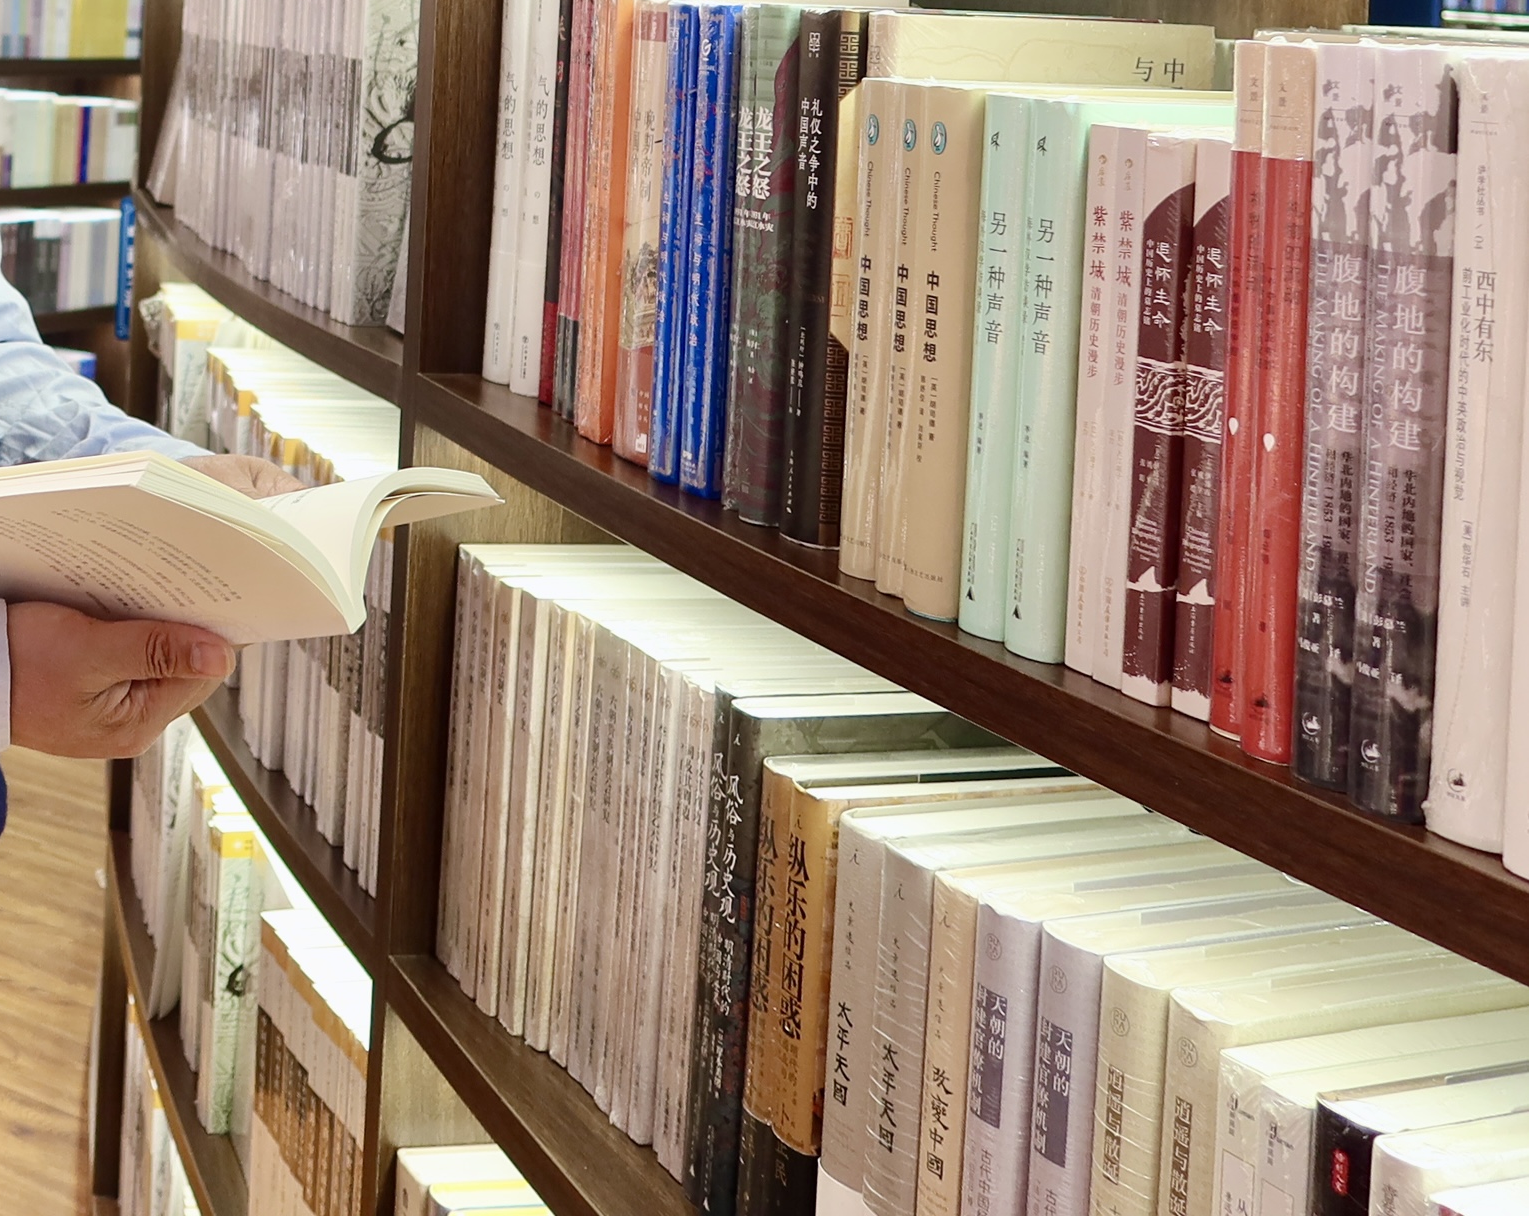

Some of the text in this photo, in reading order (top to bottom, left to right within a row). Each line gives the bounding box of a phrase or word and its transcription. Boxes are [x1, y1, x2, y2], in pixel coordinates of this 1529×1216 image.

[1133, 56, 1154, 84] 与
[1164, 56, 1186, 83] 中
[500, 71, 519, 161] 气的思想
[531, 74, 550, 168] 气的思想
[735, 105, 754, 198] 龙王之怒
[752, 105, 774, 201] 龙王之怒
[798, 98, 810, 172] 中国声音
[805, 98, 823, 210] 礼仪之争中的
[863, 161, 875, 238] Chinese Thought
[901, 167, 912, 246] Chinese Thought
[930, 171, 942, 253] Chinese Thought
[1089, 204, 1108, 282] 紫禁城
[985, 210, 1007, 345] 另一种声音
[1031, 217, 1056, 356] 另一种声音
[1115, 210, 1135, 288] 紫禁城
[1152, 239, 1171, 330] 追怀生命
[1203, 246, 1224, 337] 追怀生命
[855, 254, 873, 342] 中国思想
[893, 263, 910, 353] 中国思想
[922, 270, 941, 363] 中国思想
[1086, 286, 1103, 379] 清朝历史漫步
[1113, 291, 1128, 386] 清朝历史漫步
[1472, 269, 1497, 364] 西中有东
[1326, 253, 1363, 435] 腹地的构建
[1372, 309, 1388, 393] MAKING
[1388, 264, 1428, 453] 腹地的构建
[704, 751, 727, 900] 风俗与历史观
[719, 774, 743, 926] 风俗与历史观
[779, 830, 811, 1043] 纵乐的困惑
[987, 992, 1007, 1062] 天朝的
[1053, 1022, 1073, 1097] 天朝的
